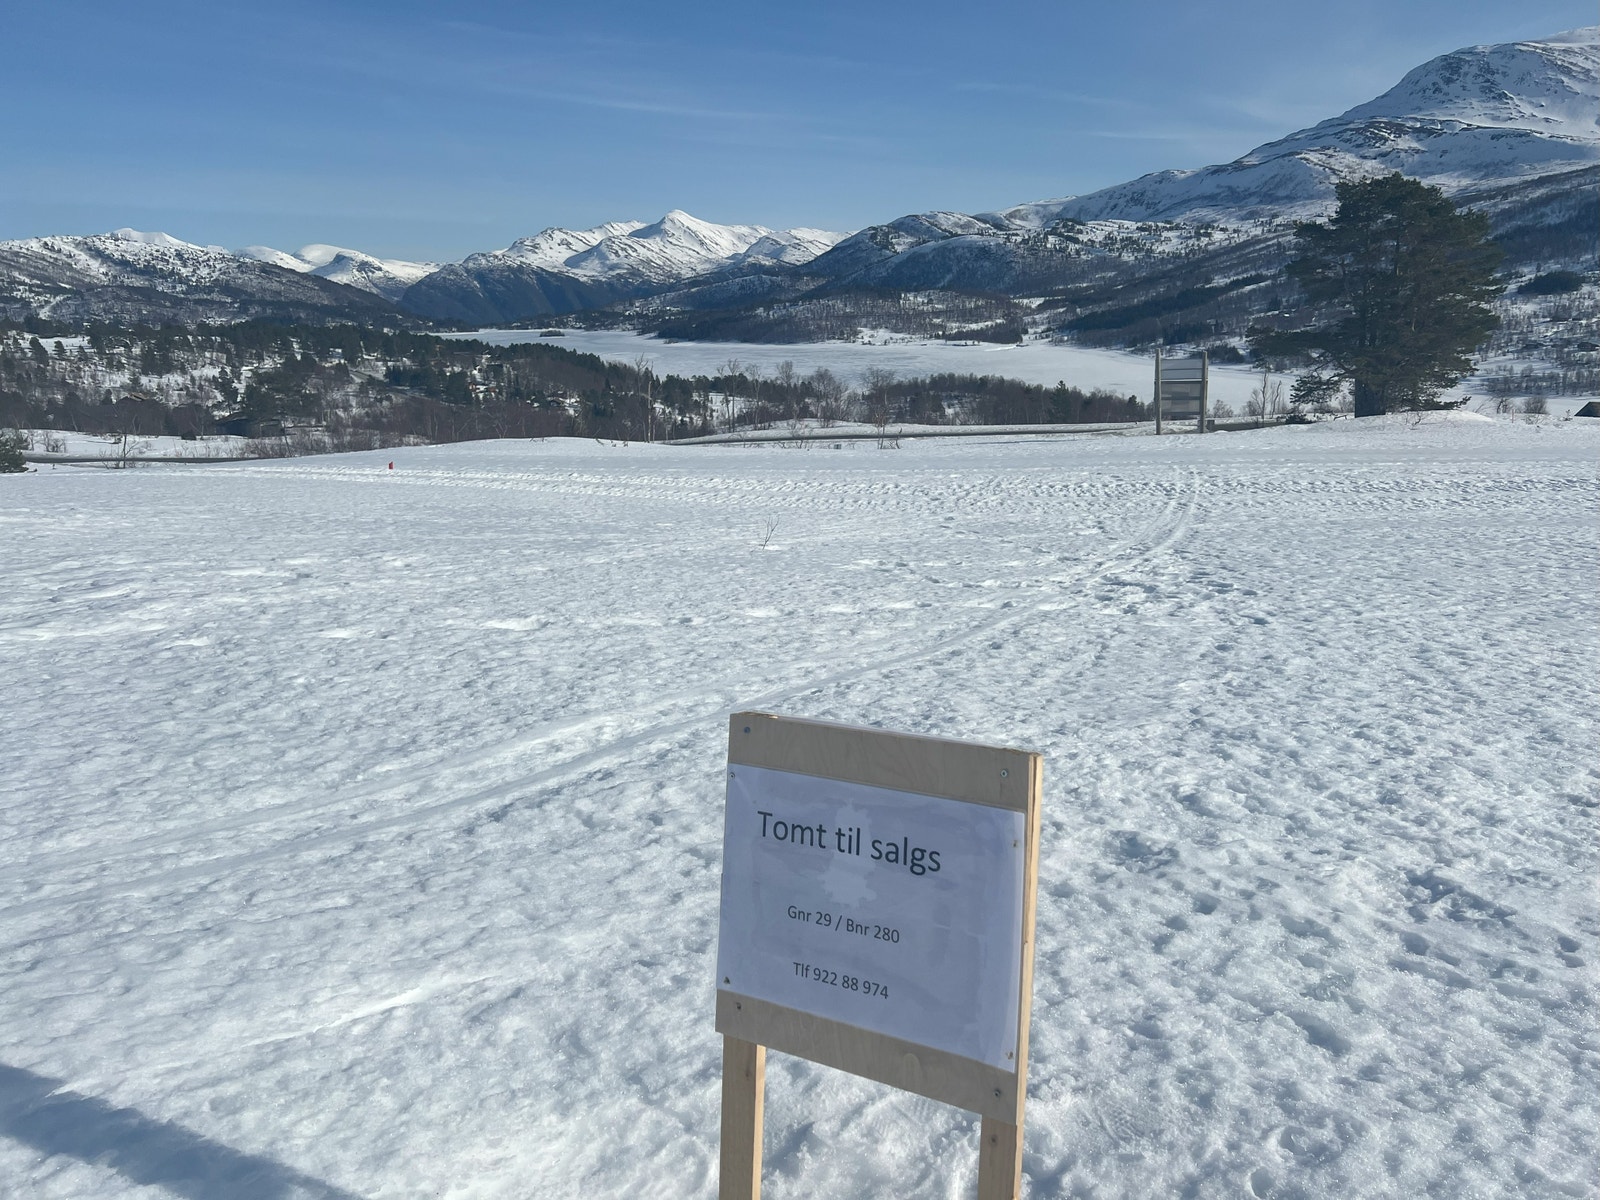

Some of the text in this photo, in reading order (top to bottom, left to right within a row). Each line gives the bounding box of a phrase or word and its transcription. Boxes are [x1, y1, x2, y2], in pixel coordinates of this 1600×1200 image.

[757, 810, 941, 876] Tomt til salgs
[787, 905, 900, 944] Gnr 29 / Bnr 280
[793, 961, 889, 1000] Tlf 922 88 974
